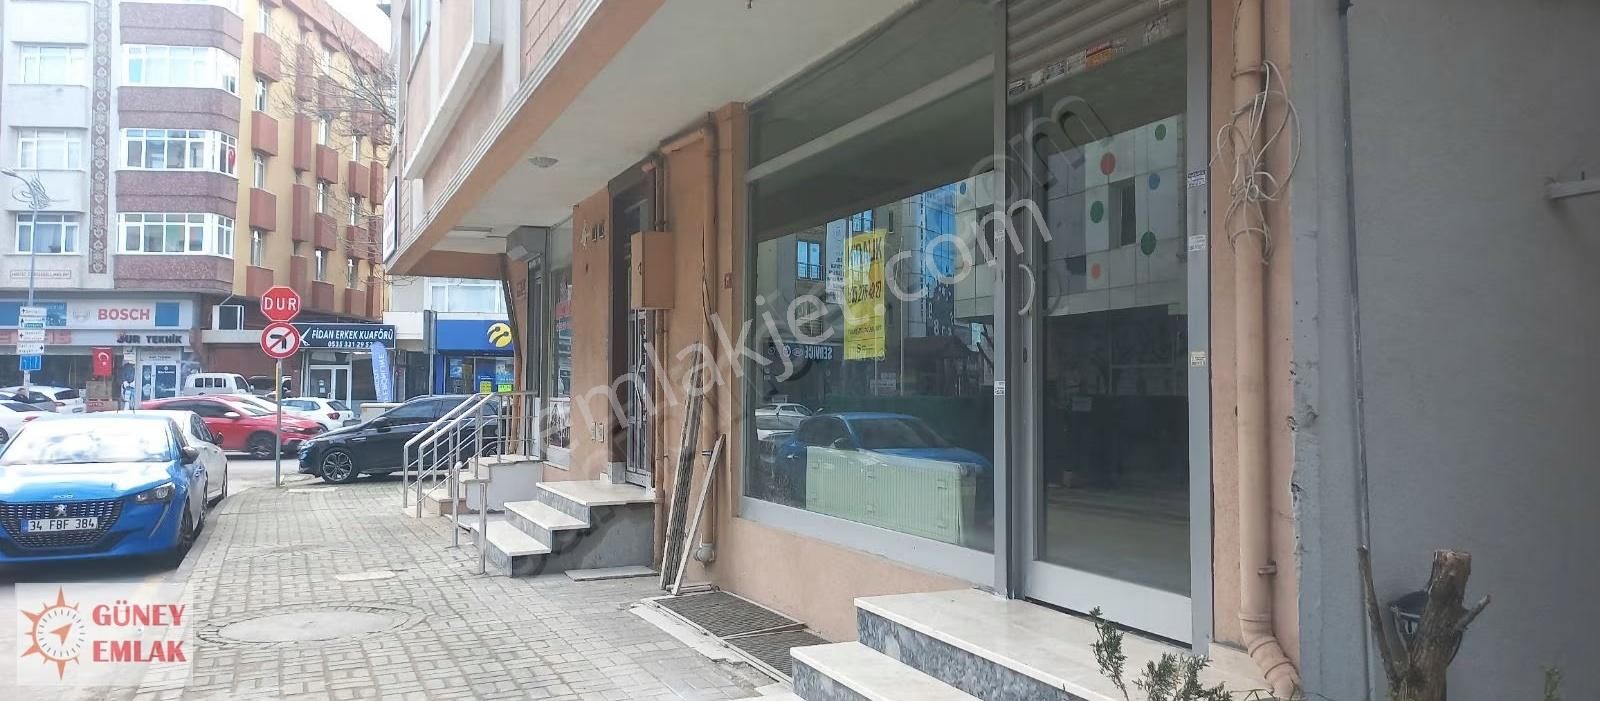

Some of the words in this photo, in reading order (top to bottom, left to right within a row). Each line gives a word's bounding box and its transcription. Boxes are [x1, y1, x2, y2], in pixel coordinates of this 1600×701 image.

[264, 296, 297, 311] DUR
[98, 308, 150, 320] BOSCH
[146, 333, 182, 344] TEKNİK
[311, 328, 334, 339] FİDAN
[335, 330, 358, 339] ERKEK
[359, 328, 393, 340] KUAFÖRÜ
[30, 521, 42, 531] 34
[49, 519, 69, 530] FBF
[75, 518, 94, 528] 384
